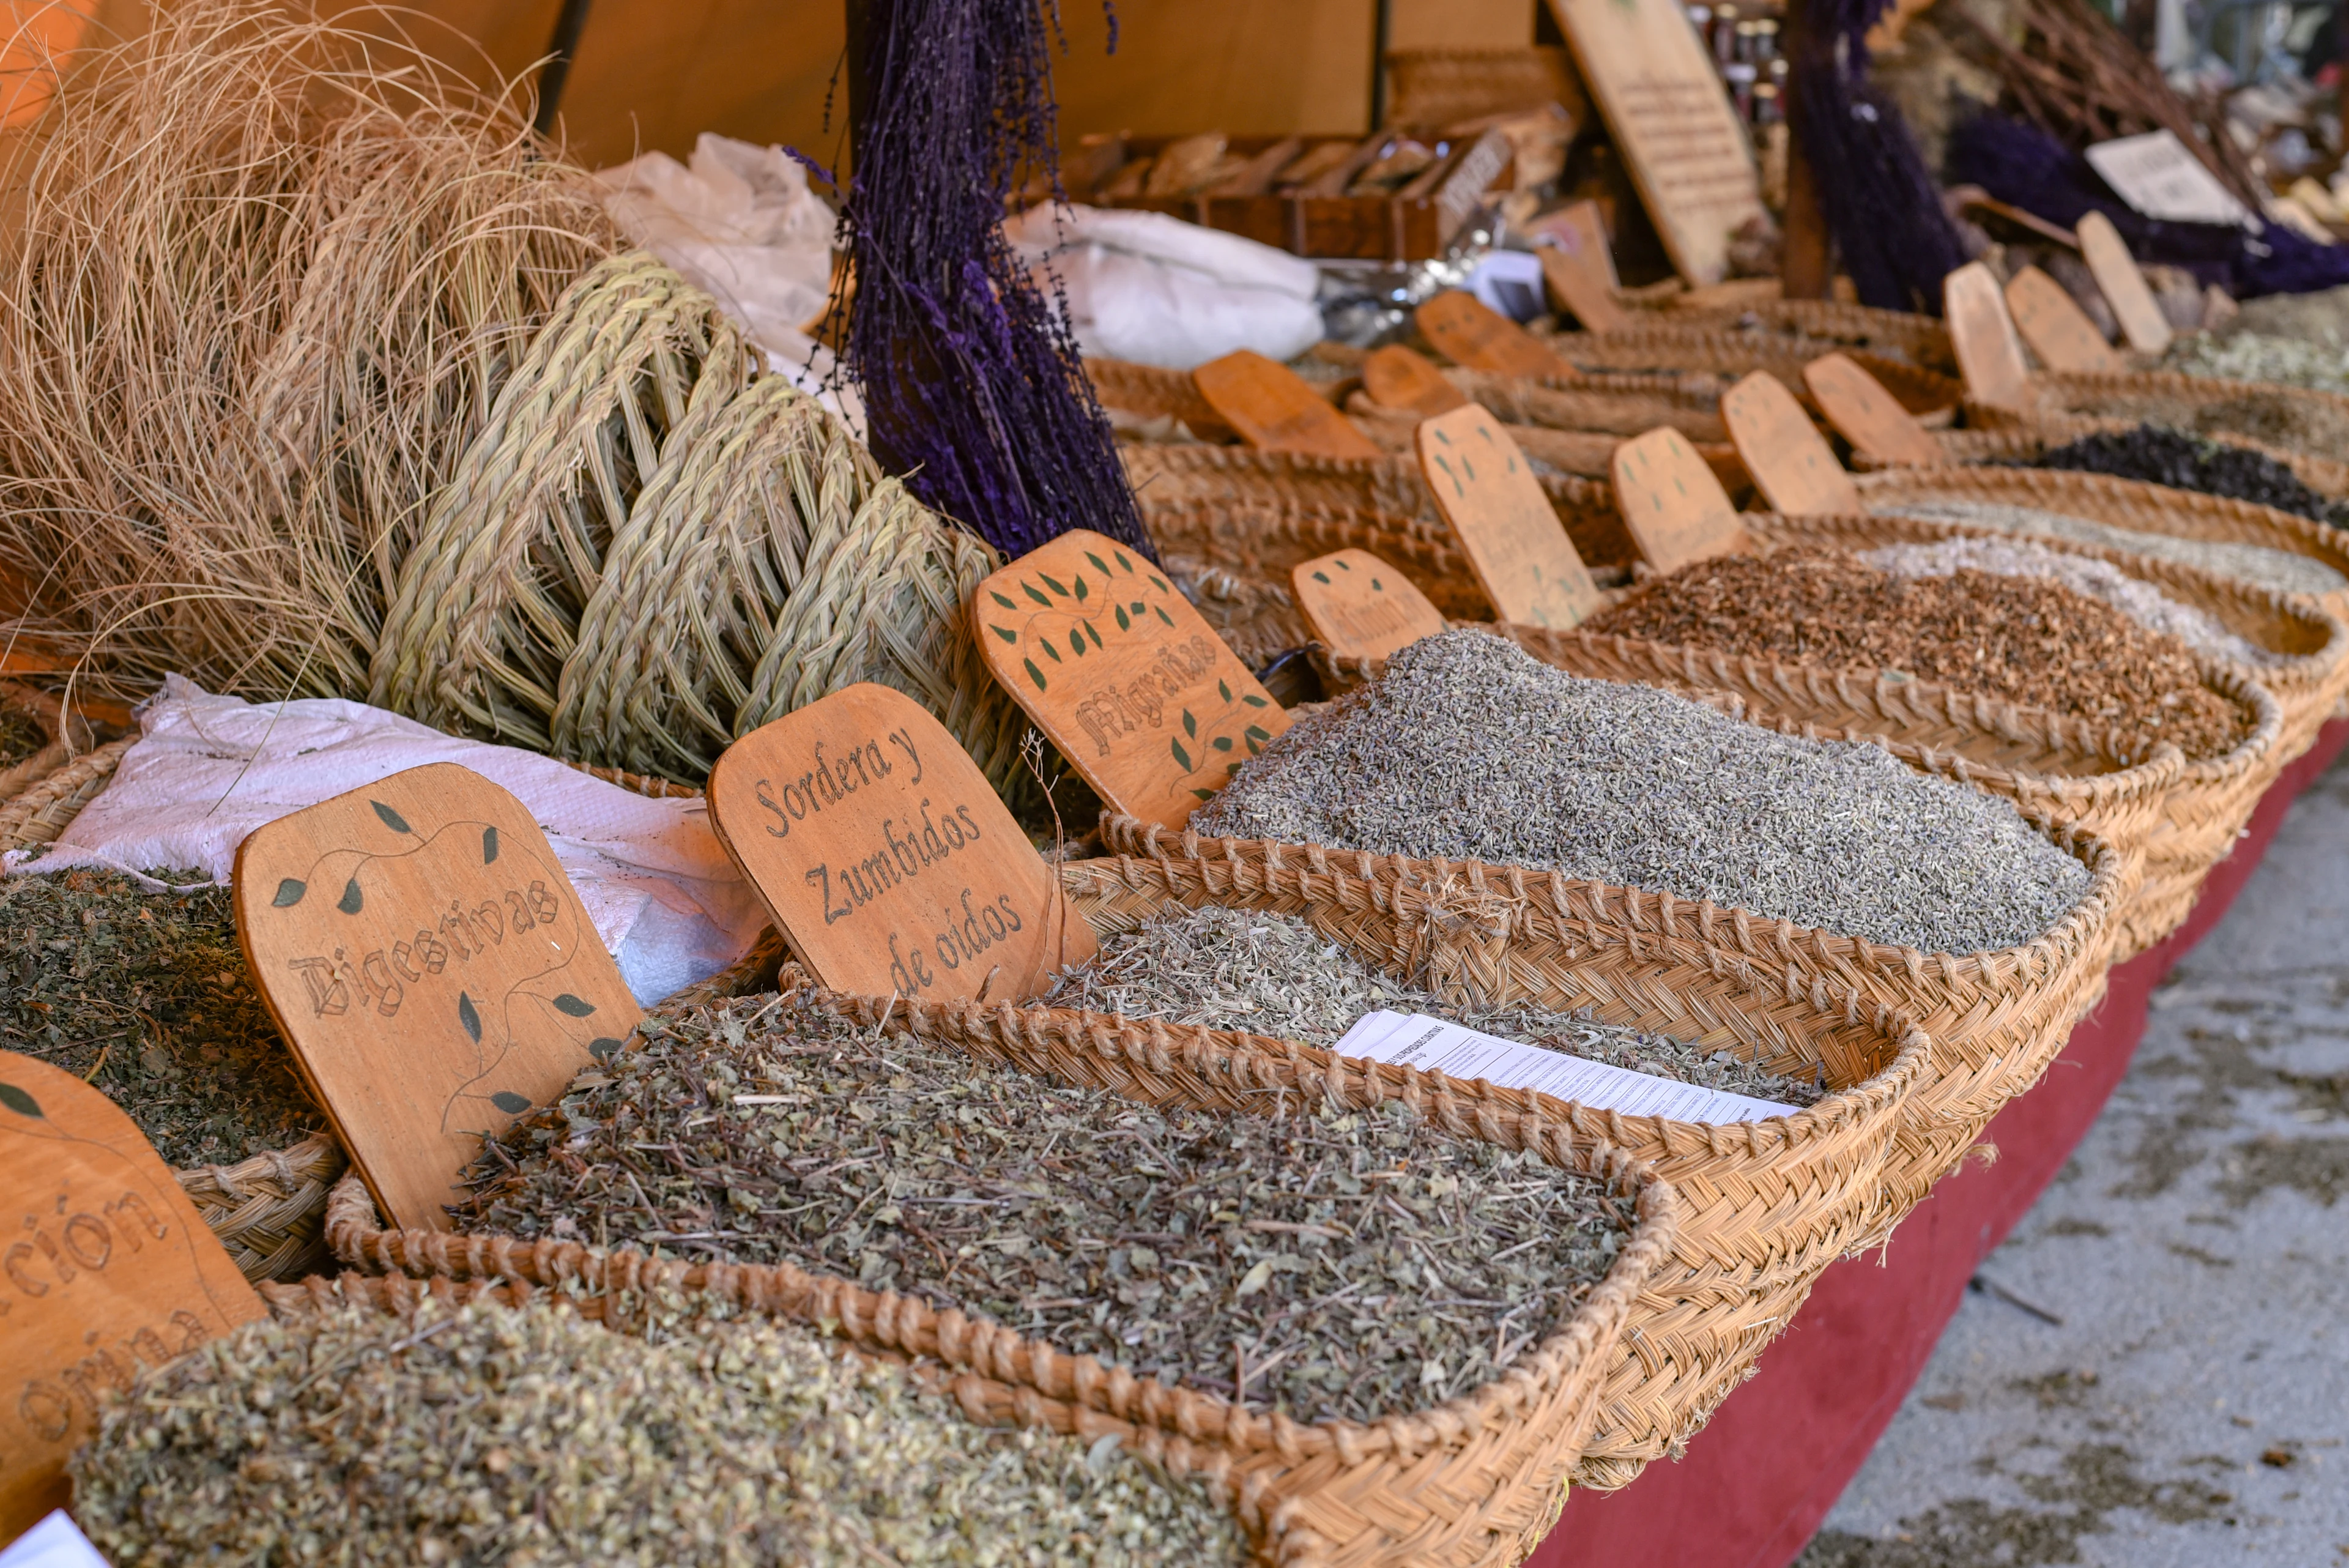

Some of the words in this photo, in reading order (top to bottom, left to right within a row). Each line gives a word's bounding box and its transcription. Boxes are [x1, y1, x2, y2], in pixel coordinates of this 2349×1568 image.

[755, 738, 892, 838] Sordera
[889, 727, 923, 786] y
[805, 797, 981, 926] Zumbidos
[288, 880, 558, 1019] Digestivas
[889, 932, 933, 1000] de
[1420, 1025, 1444, 1041] CURATIVAS
[0, 1192, 168, 1316] ción
